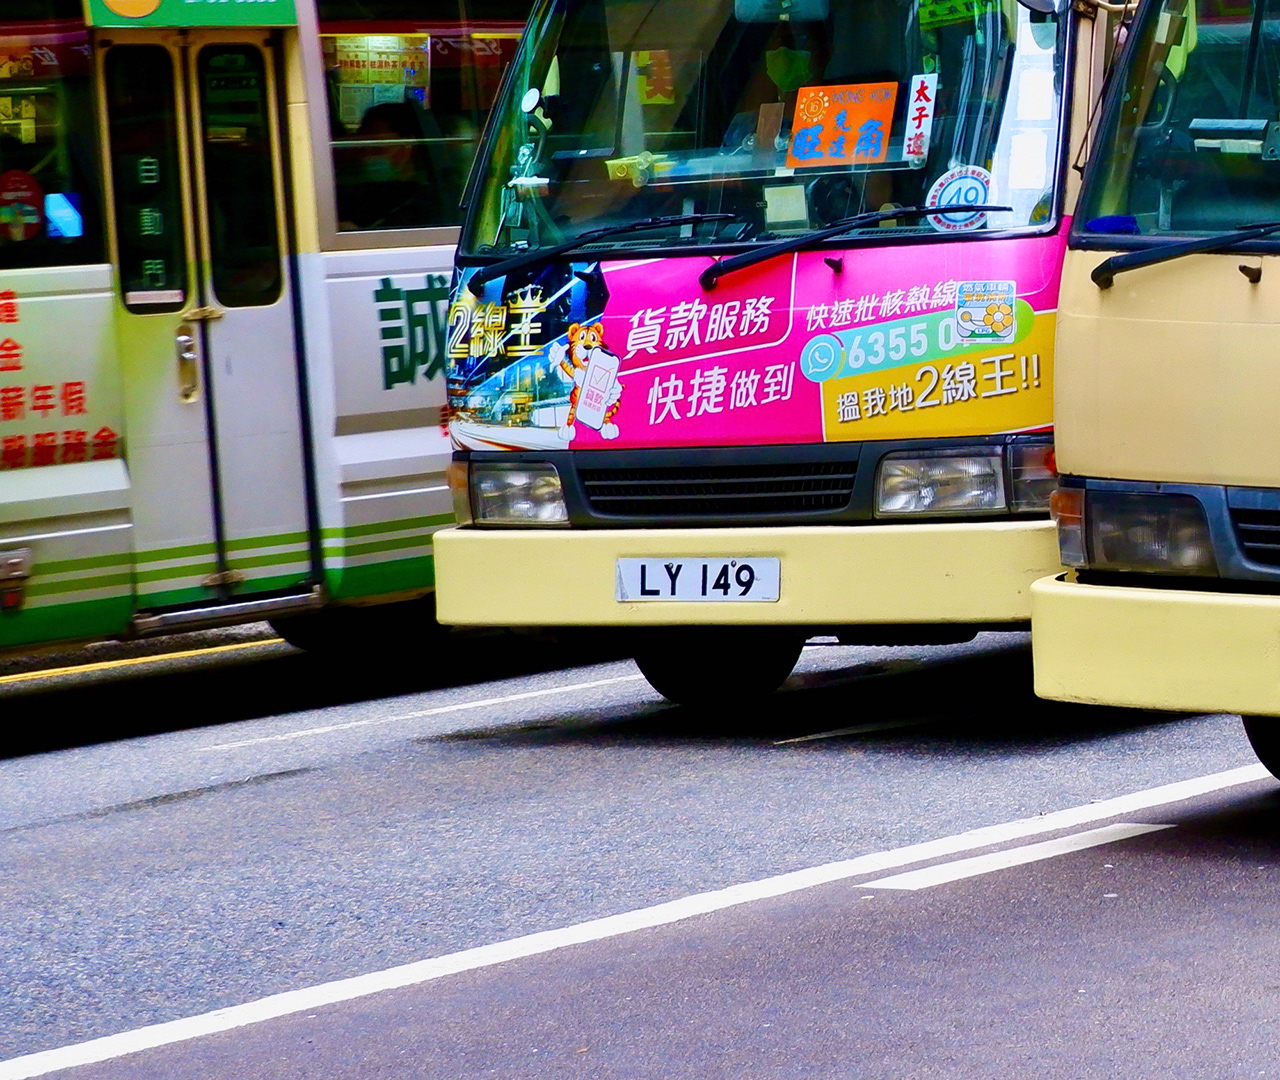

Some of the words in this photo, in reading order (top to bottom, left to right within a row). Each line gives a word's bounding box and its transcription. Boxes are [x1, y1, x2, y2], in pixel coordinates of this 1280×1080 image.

[791, 118, 885, 161] 旺角
[906, 79, 933, 156] 太子道
[136, 155, 165, 289] 自動門
[804, 279, 959, 334] 快速批核熱線
[848, 320, 929, 370] 6355
[646, 360, 797, 428] 快捷做到
[639, 563, 683, 597] LY
[700, 563, 756, 597] 149
